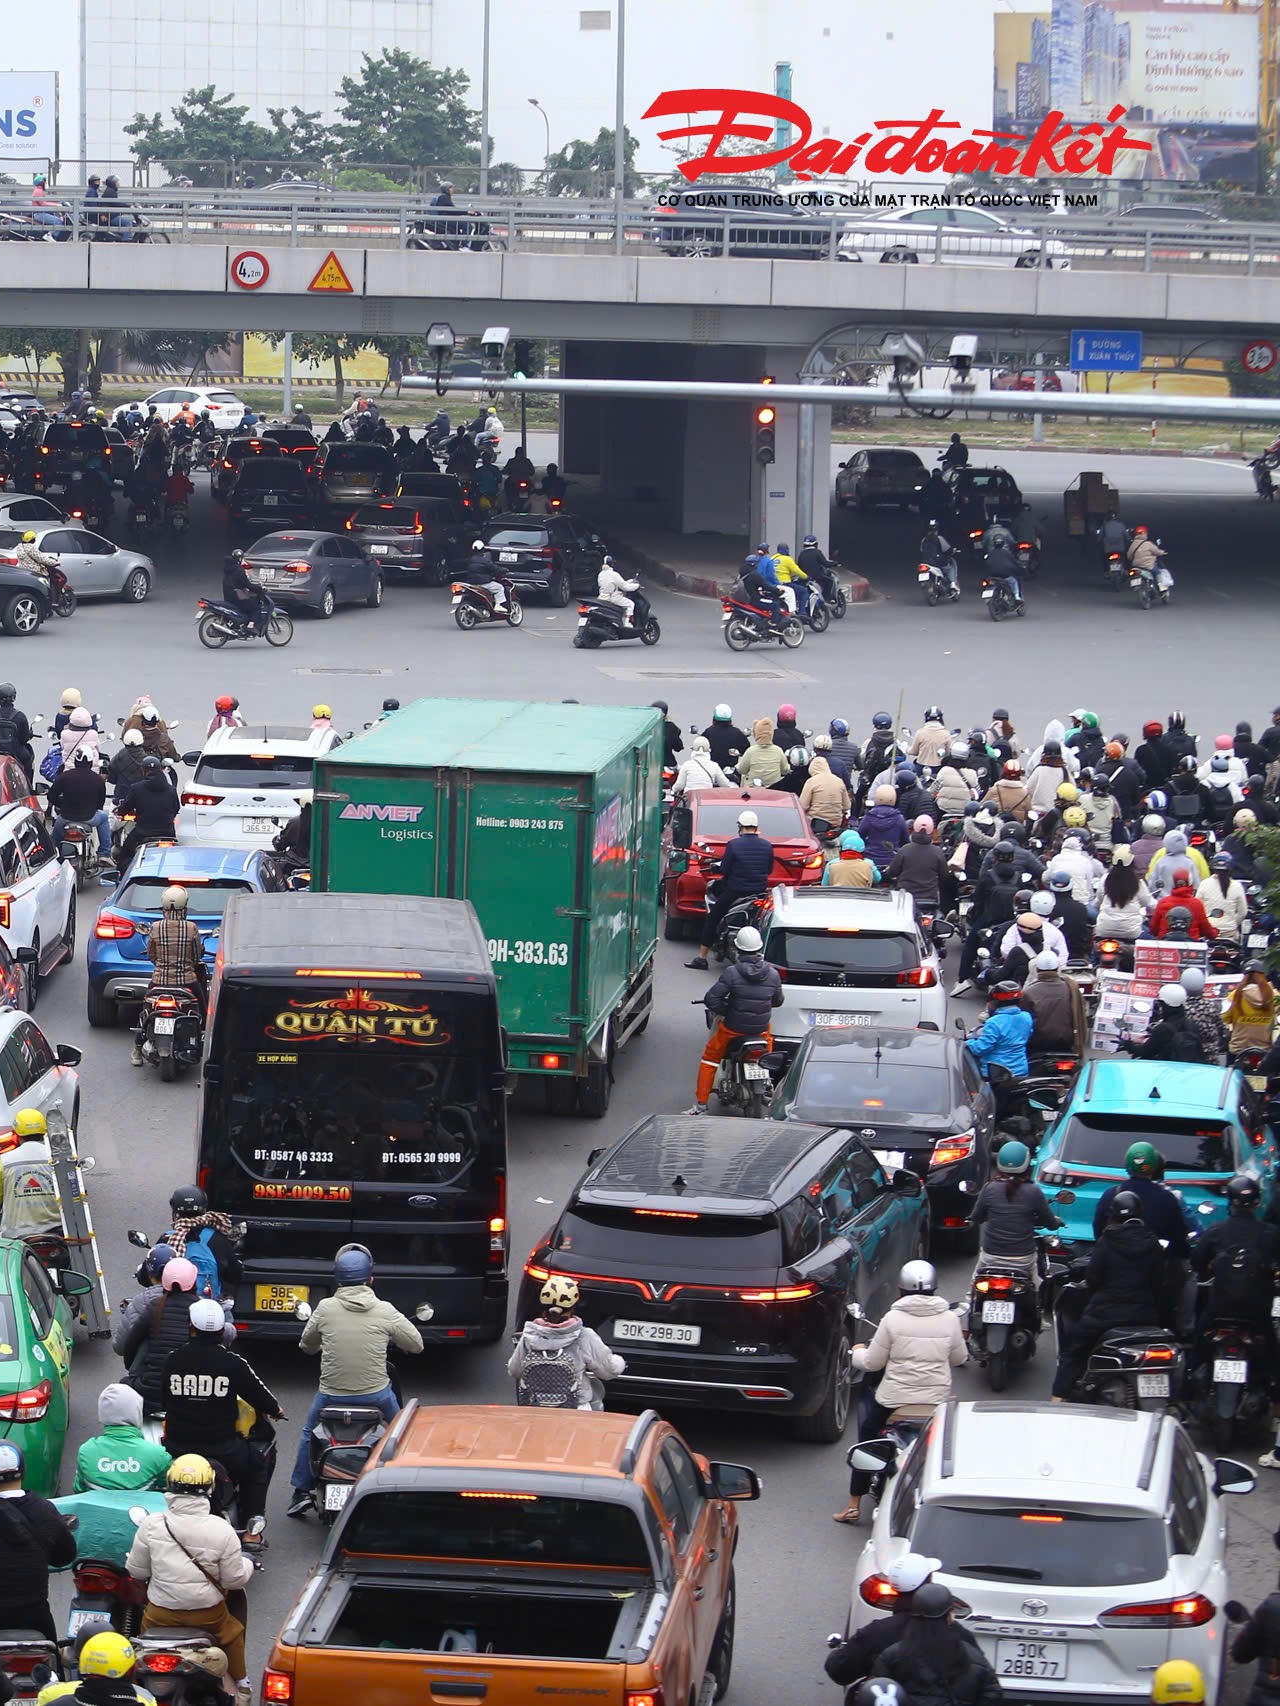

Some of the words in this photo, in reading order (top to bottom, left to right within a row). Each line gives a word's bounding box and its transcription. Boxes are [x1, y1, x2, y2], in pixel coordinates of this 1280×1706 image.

[338, 803, 424, 822] ANVIET
[476, 816, 507, 828] Hotline:
[532, 820, 547, 829] 243
[548, 820, 564, 830] 875
[380, 827, 434, 841] Logistics
[486, 939, 568, 966] 9H-383.63
[275, 1008, 379, 1036] QUÂN
[384, 1010, 439, 1038] TỨ
[254, 1149, 269, 1160] ĐT:
[271, 1150, 294, 1161] 0587
[296, 1151, 308, 1161] 46
[310, 1152, 334, 1162] 3333
[382, 1152, 397, 1163] ĐT:
[398, 1152, 423, 1163] 0565
[424, 1153, 436, 1163] 30
[438, 1153, 461, 1163] 9999
[622, 1323, 692, 1342] 30K-298.30
[170, 1374, 230, 1397] GADC
[97, 1456, 141, 1473] Grab
[1017, 1643, 1048, 1659] 30K
[1003, 1659, 1059, 1677] 288.77
